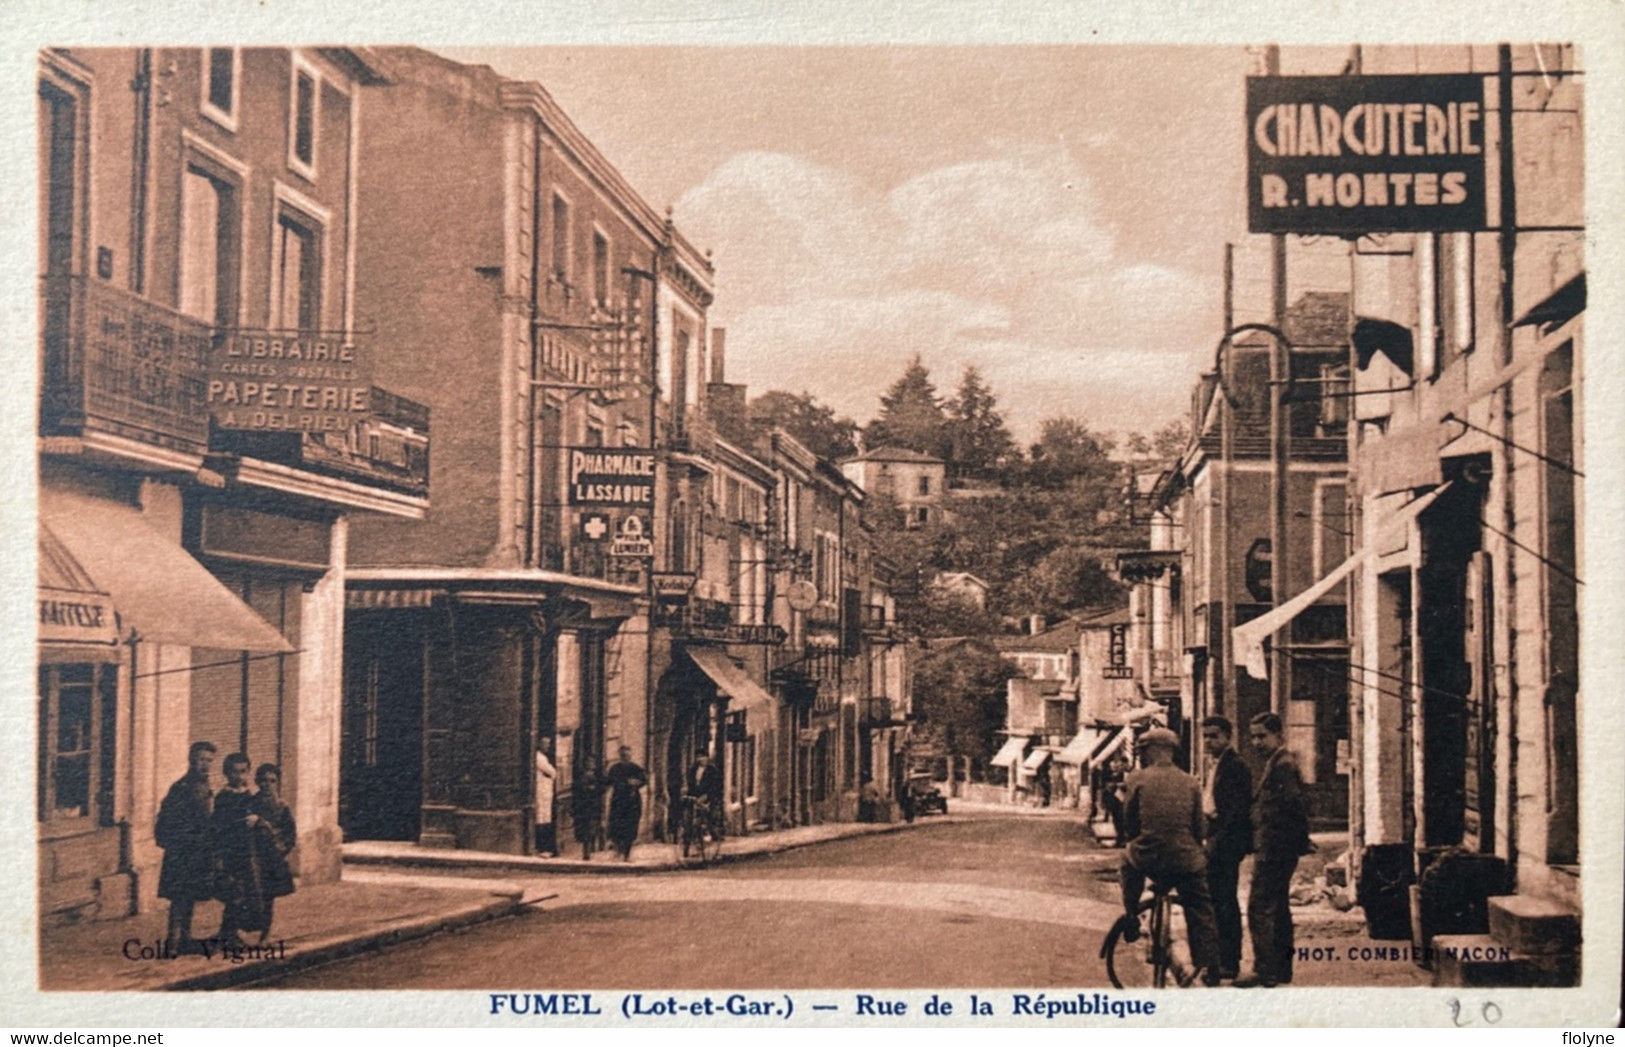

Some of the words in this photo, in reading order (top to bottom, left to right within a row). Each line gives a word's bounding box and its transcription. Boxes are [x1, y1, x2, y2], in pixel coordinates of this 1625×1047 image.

[1254, 102, 1481, 156] CHARCUTERIE
[1261, 174, 1299, 208] R.
[1305, 171, 1468, 207] MONTES
[228, 338, 356, 361] LIBRAIRIE
[222, 362, 277, 376] CARTES
[208, 380, 368, 411] PAPETERIE
[572, 450, 654, 485] PHARMACIE
[577, 484, 651, 503] LASSAQUE
